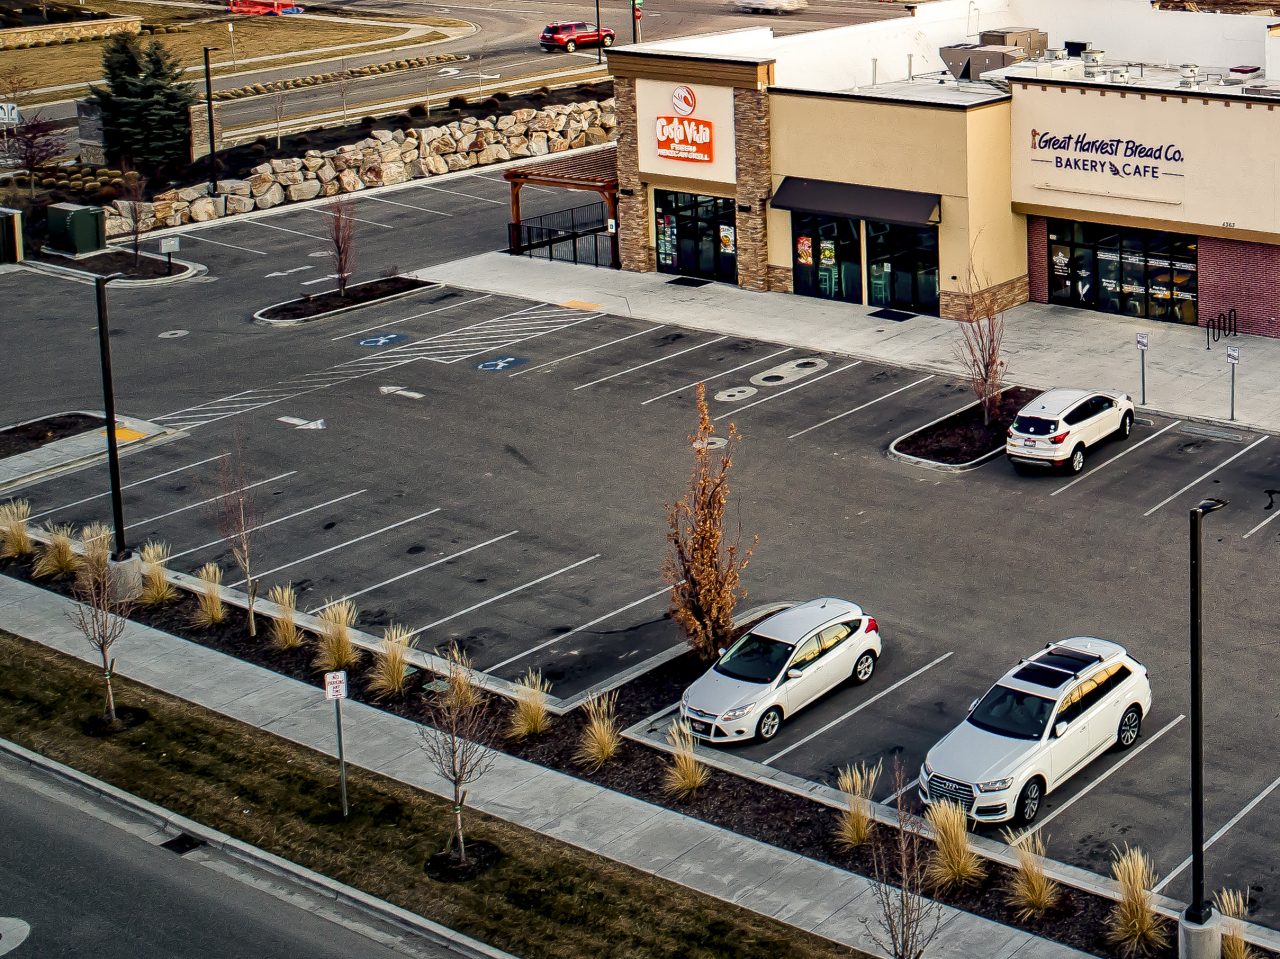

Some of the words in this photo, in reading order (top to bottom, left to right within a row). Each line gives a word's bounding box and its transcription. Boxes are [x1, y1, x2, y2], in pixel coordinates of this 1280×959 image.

[656, 118, 684, 143] Costa
[683, 120, 710, 144] Vida
[1038, 131, 1074, 150] Great
[1074, 133, 1123, 156] Harvest
[1123, 140, 1163, 160] Bread
[1164, 144, 1184, 162] Co.
[1055, 156, 1106, 173] BAKERY
[1122, 163, 1160, 178] CAFE
